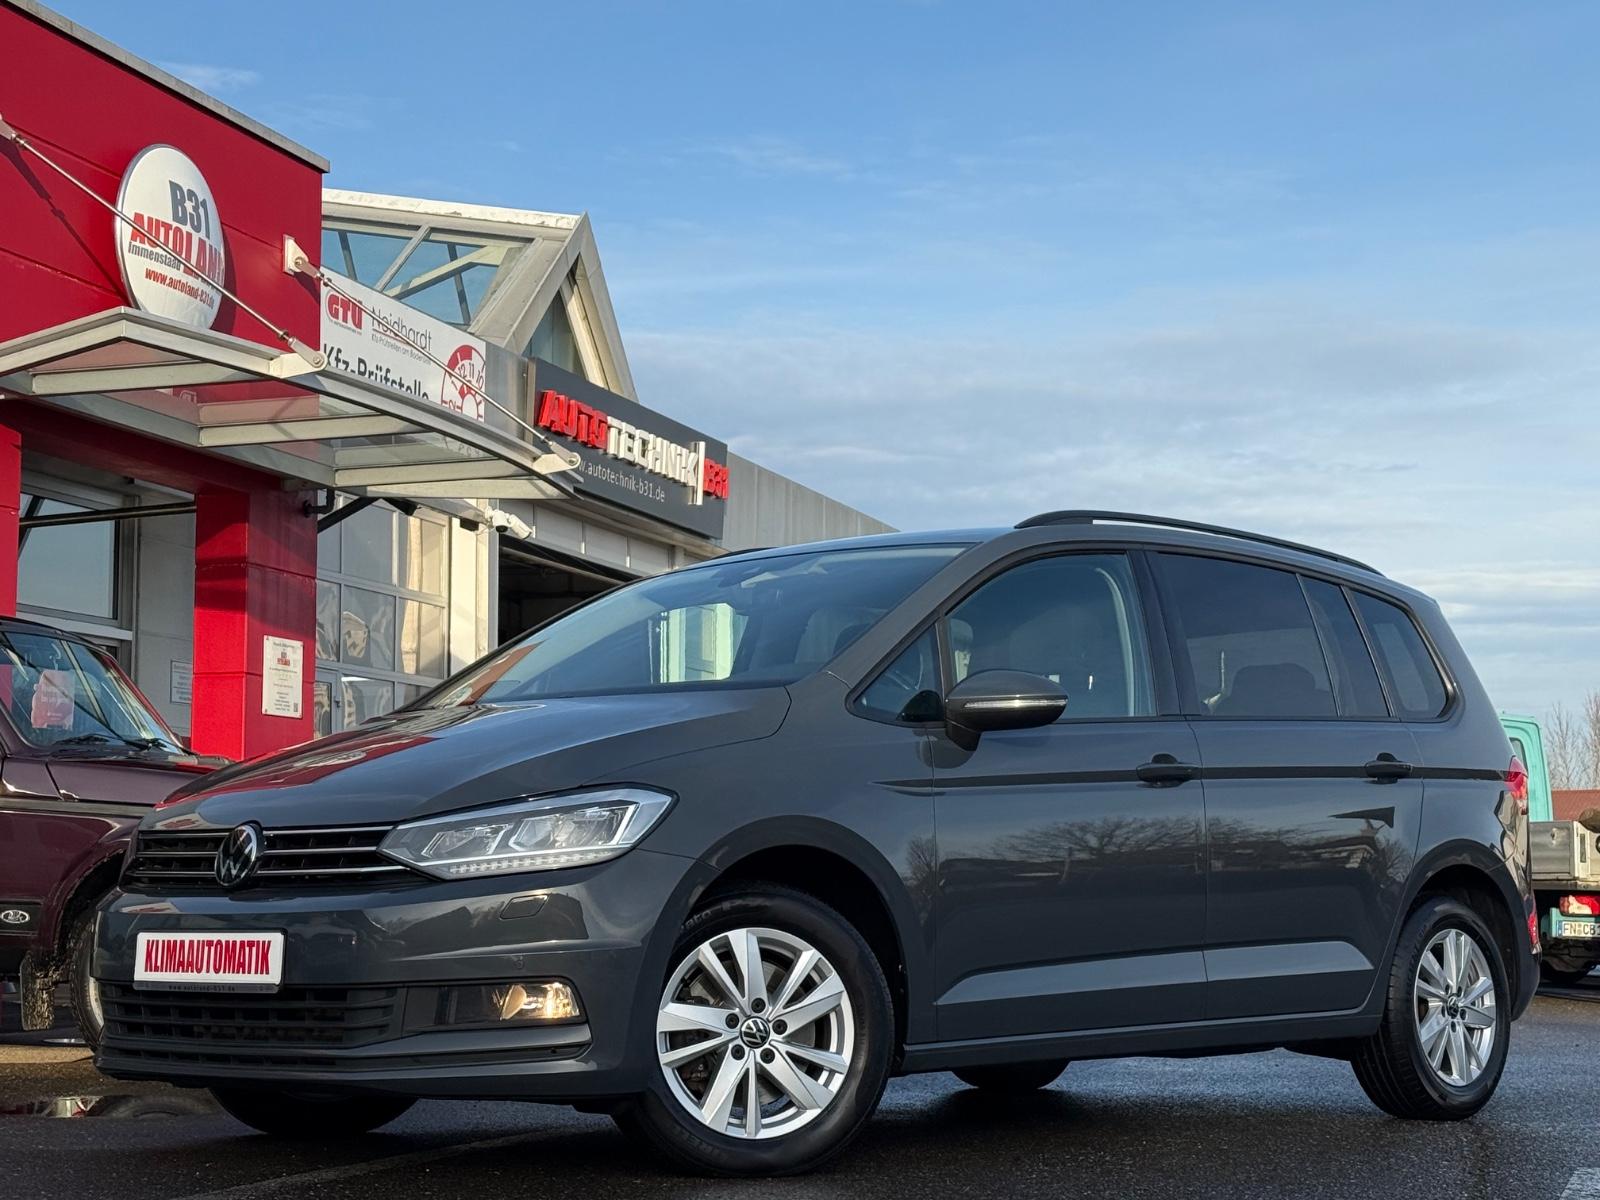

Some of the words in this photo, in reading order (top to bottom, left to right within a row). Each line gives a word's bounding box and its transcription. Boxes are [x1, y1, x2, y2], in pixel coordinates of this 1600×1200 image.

[169, 180, 211, 240] B31
[371, 306, 432, 351] Neidhardt
[538, 389, 698, 488] AUTOTECHNIK
[577, 459, 666, 503] w.autotechnik-b31.de
[1563, 922, 1577, 935] FN
[144, 939, 272, 976] KLIMAAUTOMATIK
